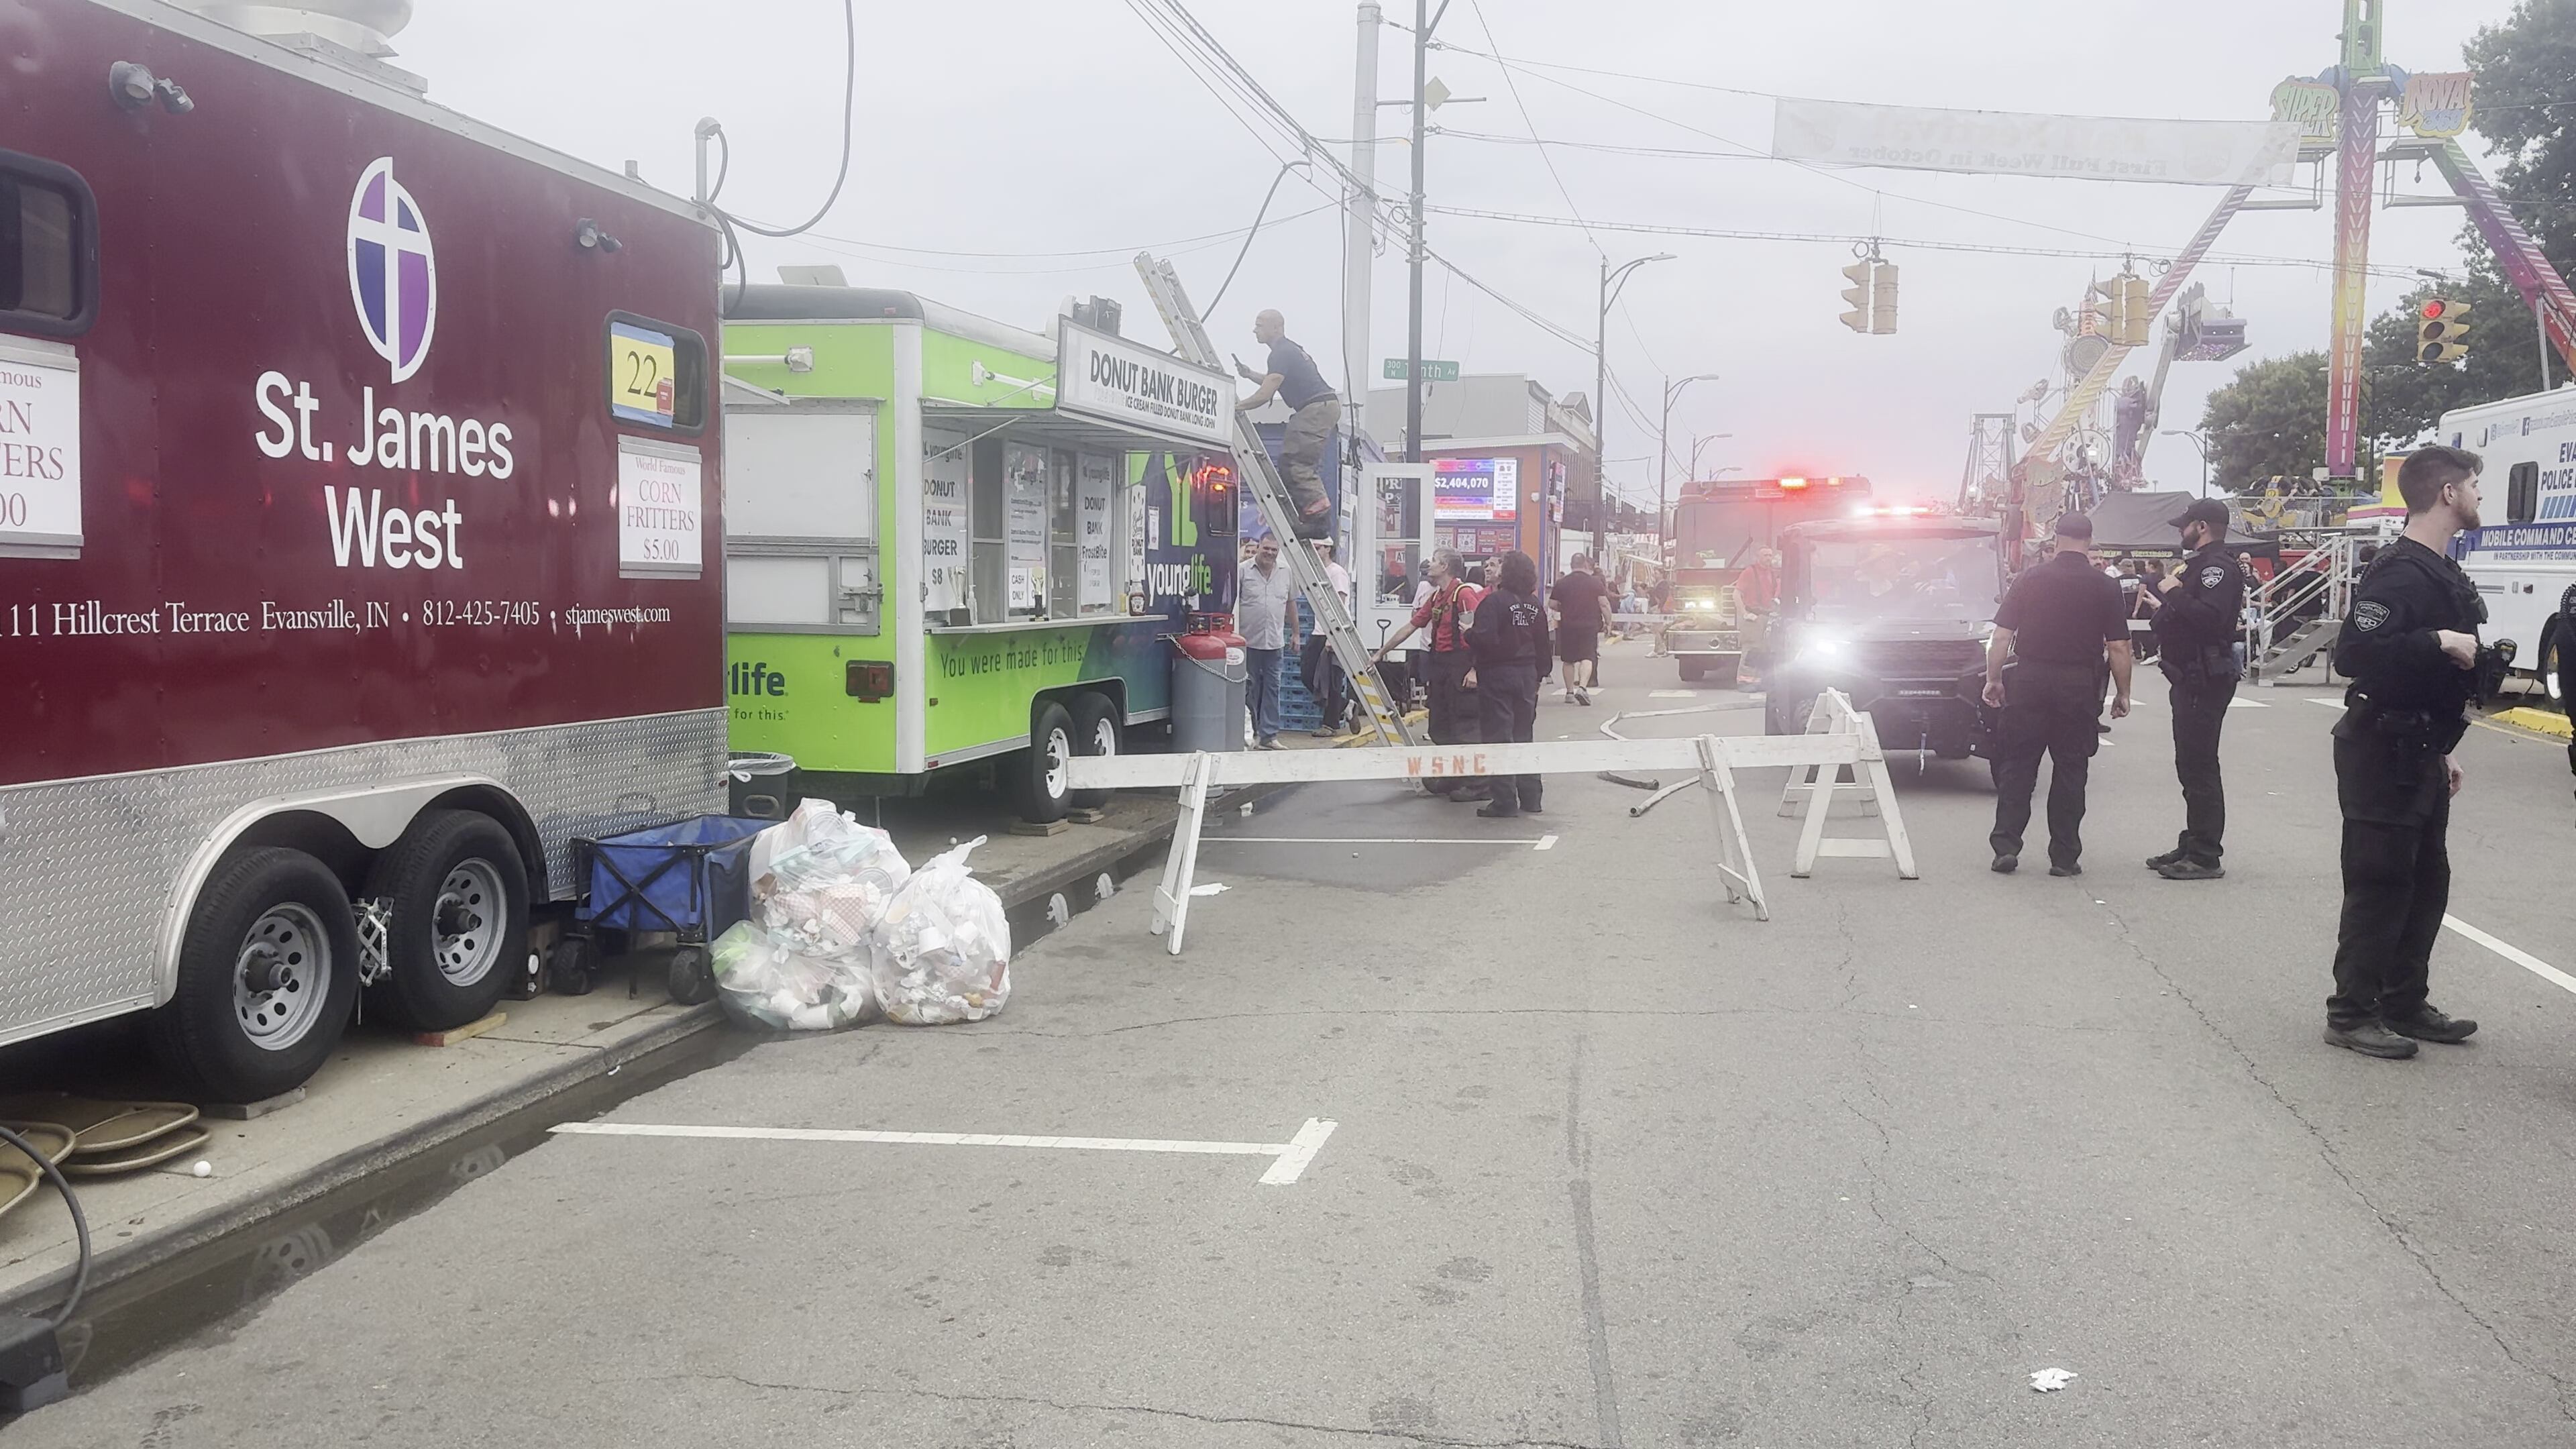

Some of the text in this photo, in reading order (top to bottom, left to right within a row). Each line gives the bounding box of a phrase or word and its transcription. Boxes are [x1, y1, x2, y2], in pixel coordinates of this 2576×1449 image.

[2405, 76, 2470, 121] NOVA
[2278, 84, 2334, 137] SUPER
[627, 350, 657, 398] 22
[1387, 360, 1401, 369] 300
[1405, 363, 1442, 378] Tnth
[1090, 350, 1138, 394] DONUT
[1140, 366, 1175, 405] BANK
[1177, 378, 1218, 417] BURGER
[1125, 394, 1133, 409] ICE
[1133, 396, 1150, 413] CREAM
[1150, 401, 1164, 417] FILLED
[1164, 406, 1179, 420] DONUT
[1179, 410, 1191, 423] BANK
[1191, 413, 1204, 426] LONG
[1203, 417, 1216, 430] JOHN
[254, 370, 514, 480] St. James
[0, 442, 64, 481] ERS
[635, 455, 686, 476] World Famous
[924, 478, 956, 498] DONUT
[1434, 477, 1489, 490] $2,404,070
[2540, 468, 2573, 491] POLICE
[639, 479, 682, 504] CORN
[1084, 496, 1106, 511] DONUT
[323, 485, 464, 570] West
[626, 506, 695, 532] FRITTERS
[926, 509, 952, 527] BANK
[1087, 521, 1104, 535] BANK
[924, 539, 958, 556] BURGER
[2481, 529, 2514, 547] MOBILE
[2514, 527, 2564, 546] COMMAND
[643, 537, 680, 561] $5.00
[1081, 544, 1108, 559] FrostBite
[2493, 552, 2499, 561] IN
[2499, 551, 2530, 561] PARTNERSHIP
[2530, 551, 2542, 561] WITH
[2544, 551, 2554, 560] THE
[932, 568, 943, 586] $8
[1011, 574, 1025, 585] CASH
[1012, 590, 1024, 601] ONLY
[0, 598, 671, 637] 11 Hillcrest Terrace Evansville, IN 812-425-7405 stjameswest.com
[941, 653, 965, 679] You
[971, 653, 1002, 675] were
[1006, 643, 1038, 670] made
[1043, 642, 1059, 666] for
[728, 661, 786, 697] life
[734, 708, 753, 720] for
